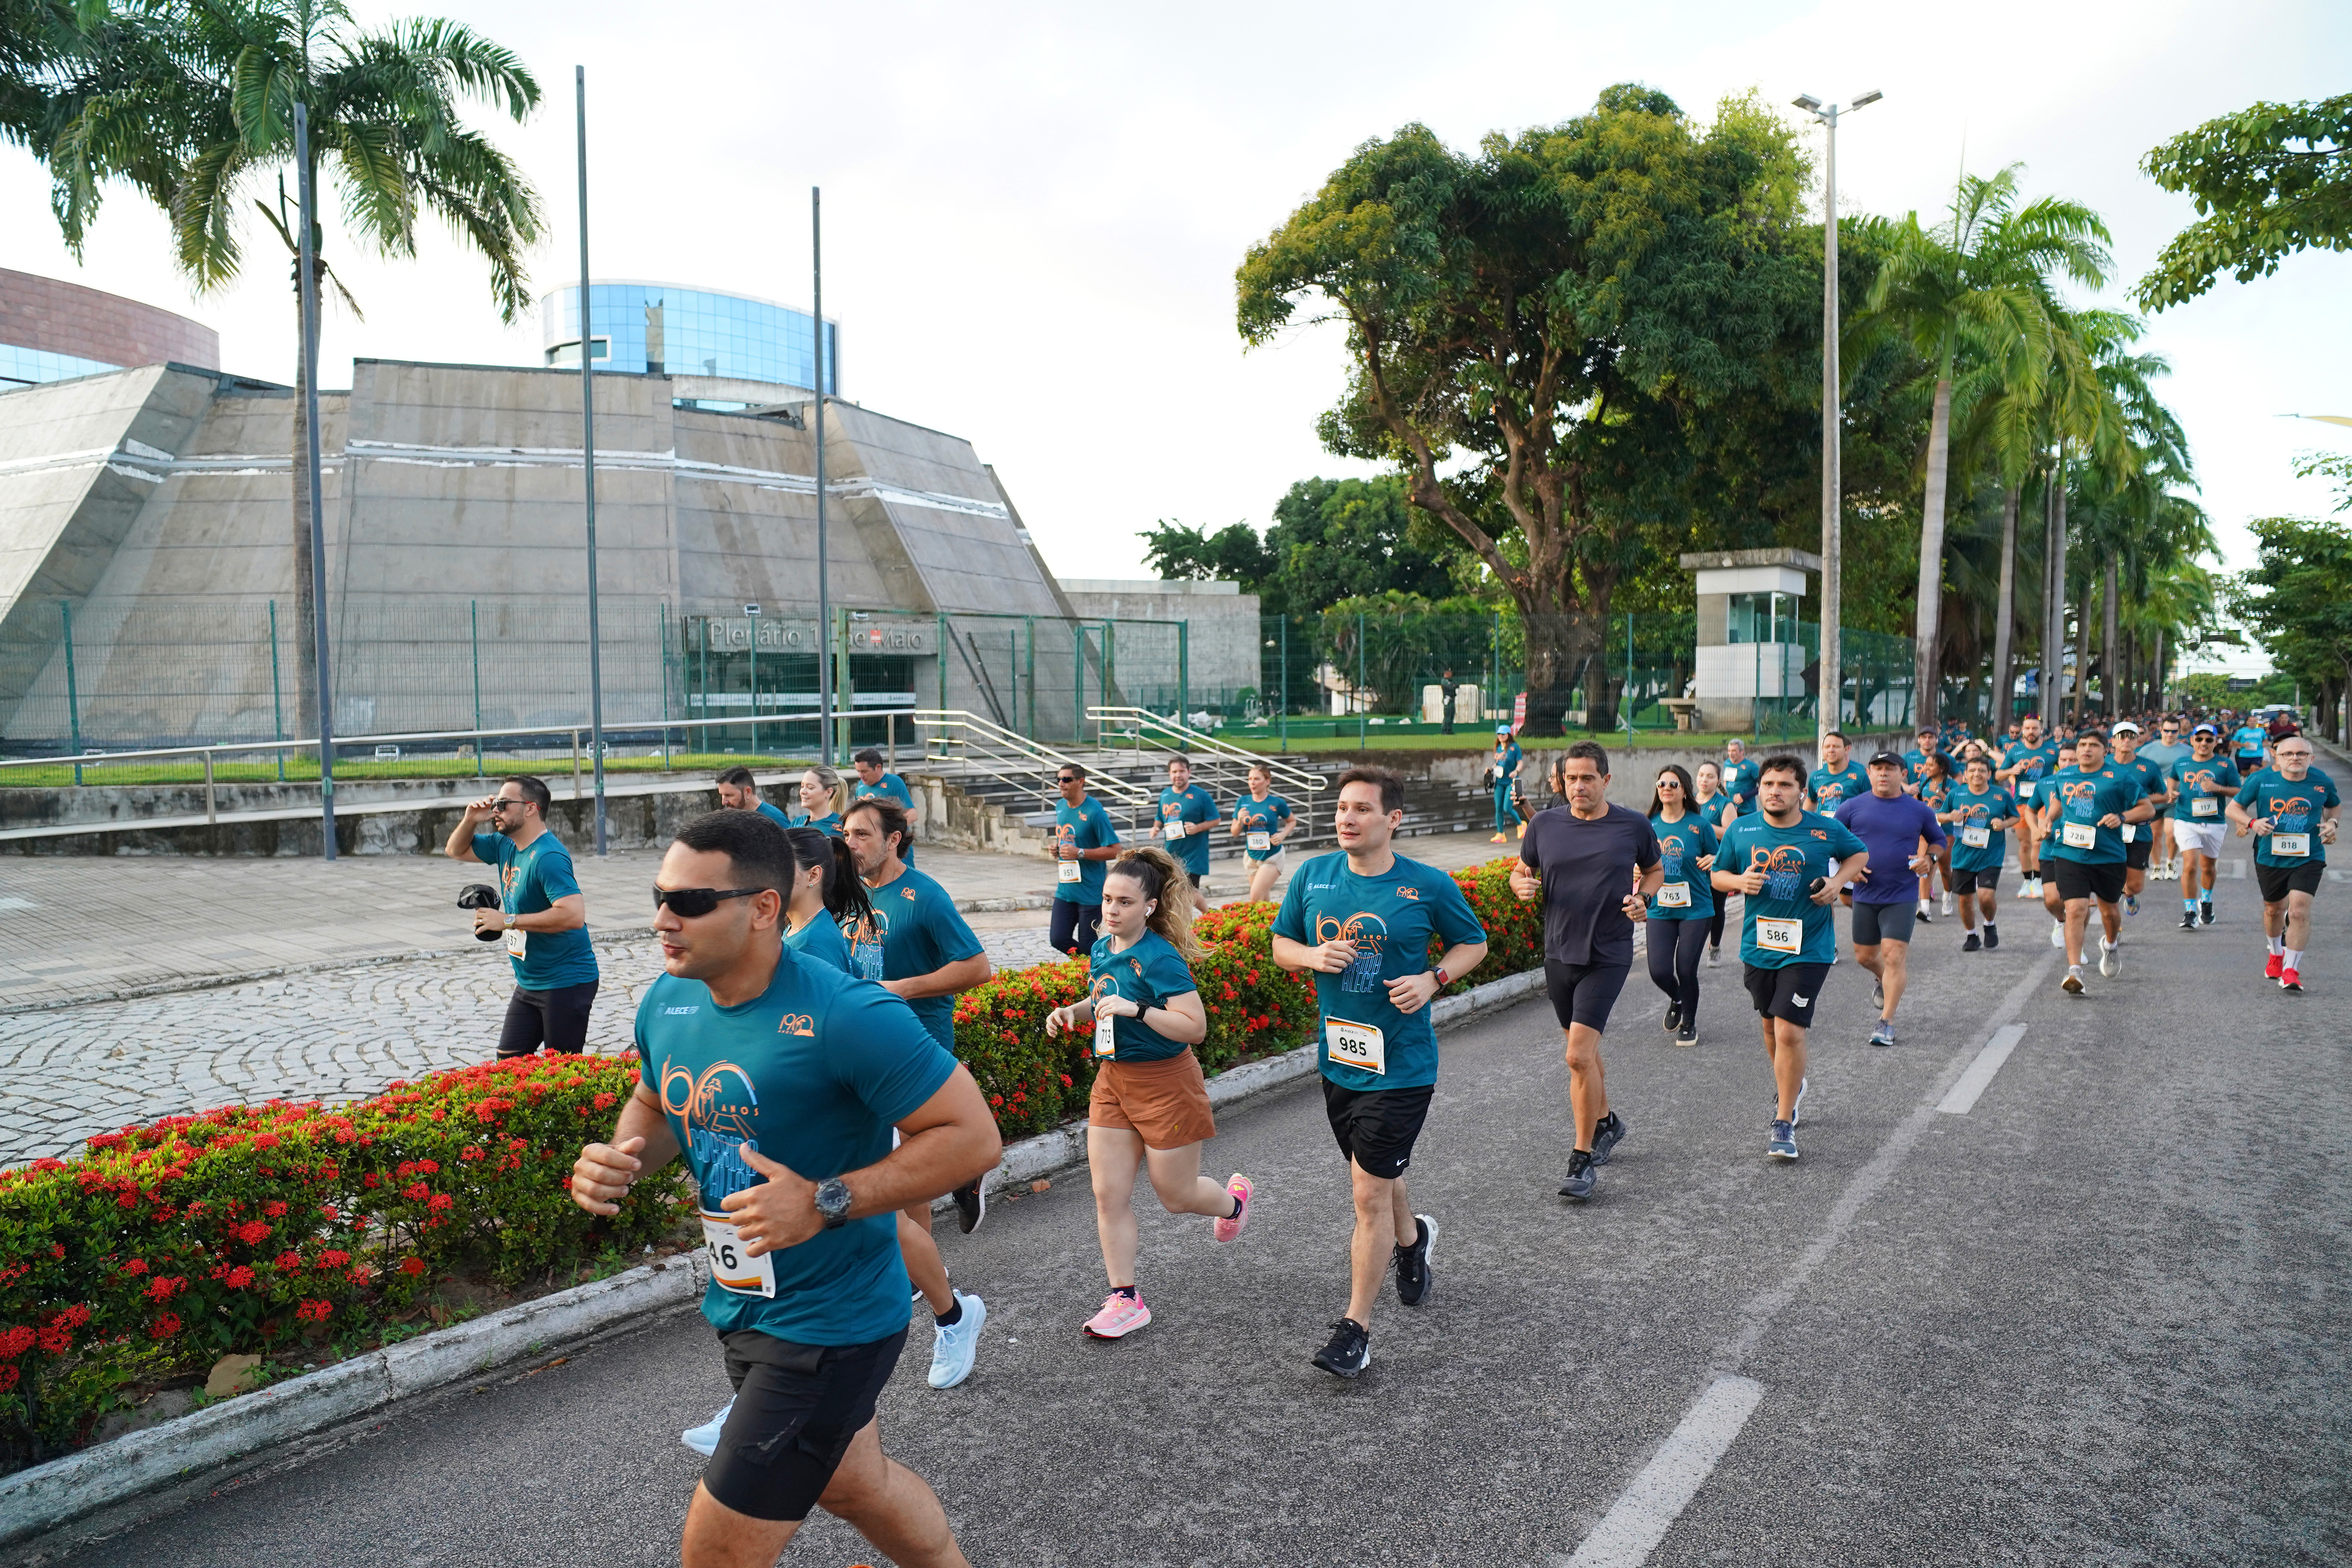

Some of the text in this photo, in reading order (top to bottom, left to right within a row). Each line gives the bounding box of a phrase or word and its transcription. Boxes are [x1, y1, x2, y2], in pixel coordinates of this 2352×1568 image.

[711, 622, 800, 647] Plenário
[873, 626, 921, 648] Maio
[2281, 841, 2297, 849] 818
[1664, 891, 1680, 900] 763
[1767, 929, 1788, 942] 586
[1341, 971, 1377, 993] ALECE
[664, 1006, 690, 1015] ALECE
[1101, 1029, 1111, 1044] 713
[1339, 1037, 1367, 1056] 985
[721, 1103, 759, 1116] ANOS
[709, 1241, 737, 1270] 46
